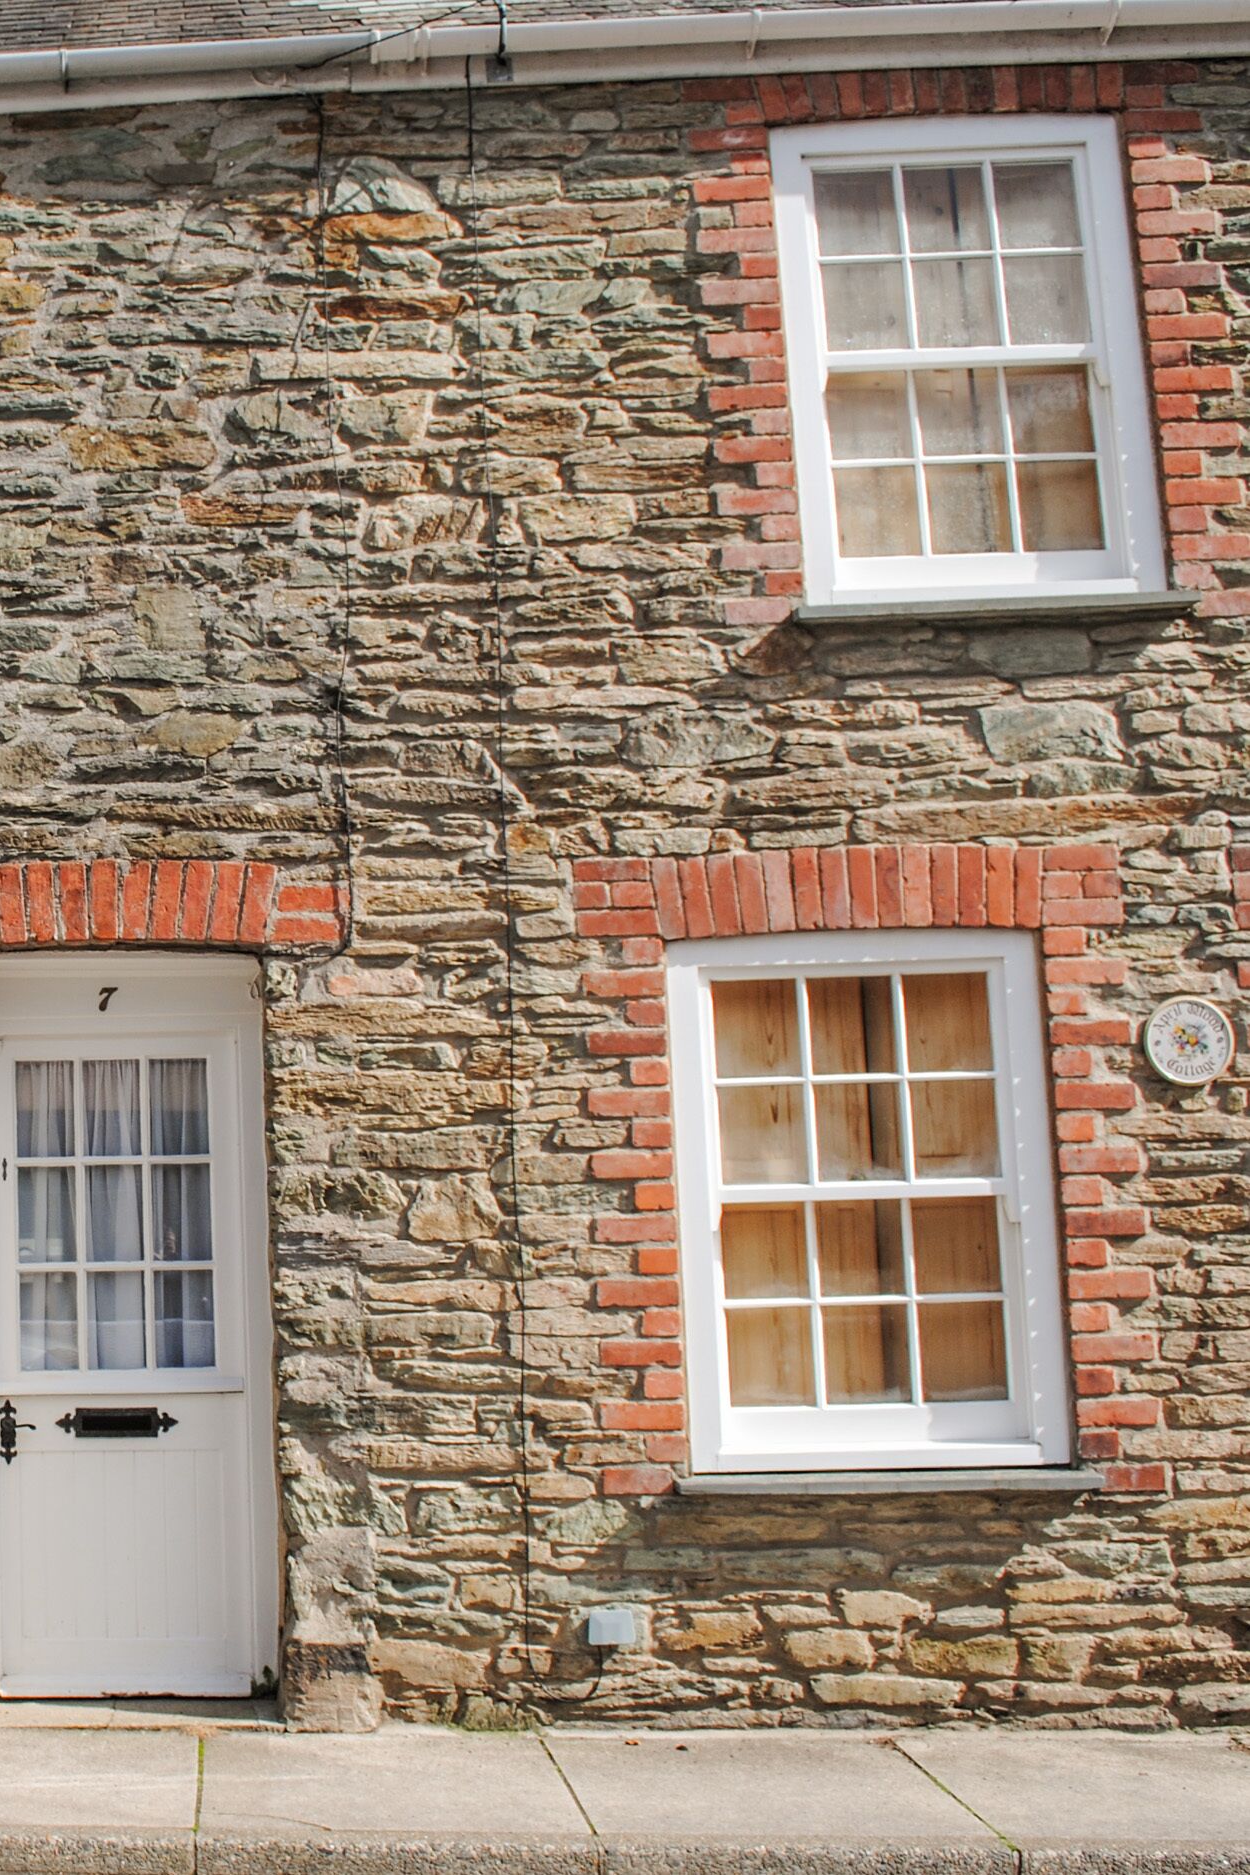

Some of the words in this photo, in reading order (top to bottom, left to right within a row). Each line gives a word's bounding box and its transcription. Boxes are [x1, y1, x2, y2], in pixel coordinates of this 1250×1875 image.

[99, 987, 118, 1012] 7
[1153, 1003, 1182, 1033] April
[1166, 1057, 1216, 1076] Cottage
